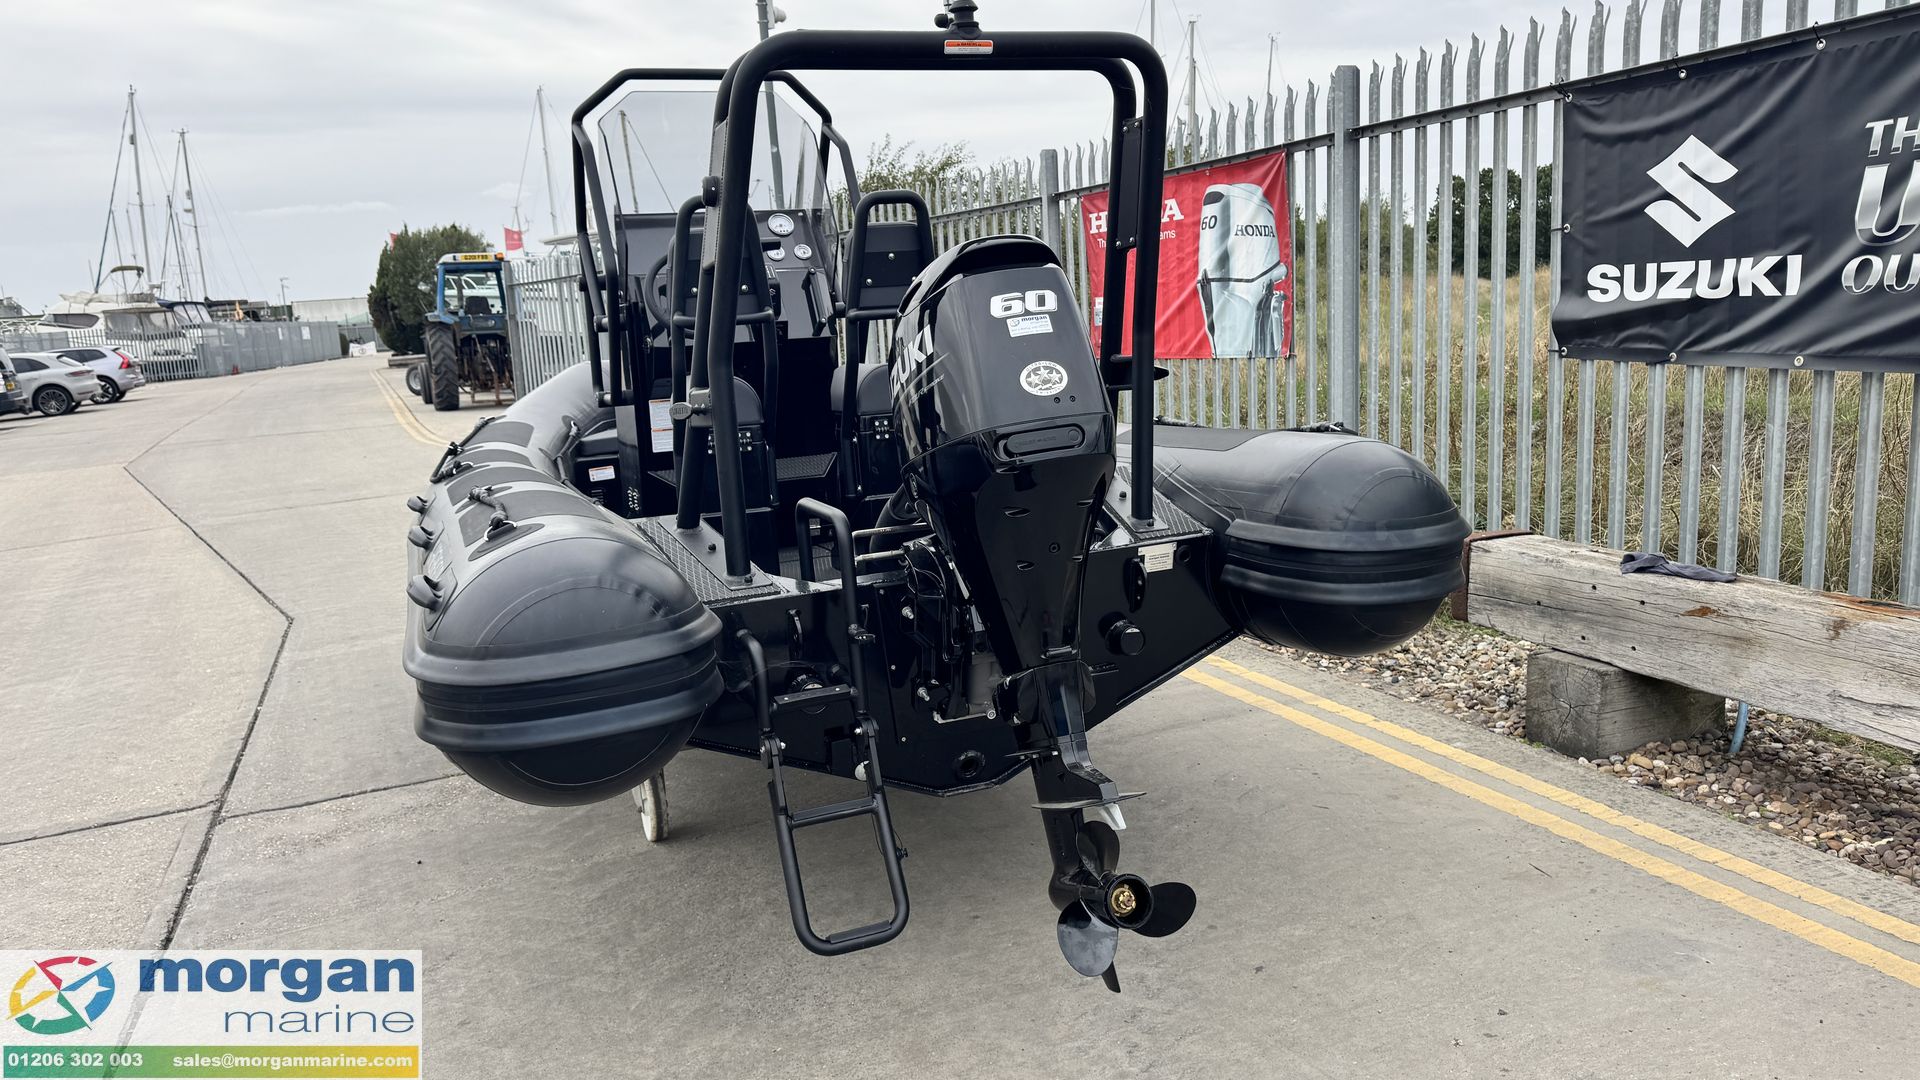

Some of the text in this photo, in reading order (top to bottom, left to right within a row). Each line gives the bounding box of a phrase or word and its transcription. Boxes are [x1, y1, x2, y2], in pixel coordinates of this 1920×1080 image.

[1201, 215, 1218, 231] 60
[1234, 224, 1276, 238] HONDA
[1587, 254, 1803, 303] SUZUKI
[990, 289, 1058, 319] 60
[889, 324, 934, 407] ZUKI
